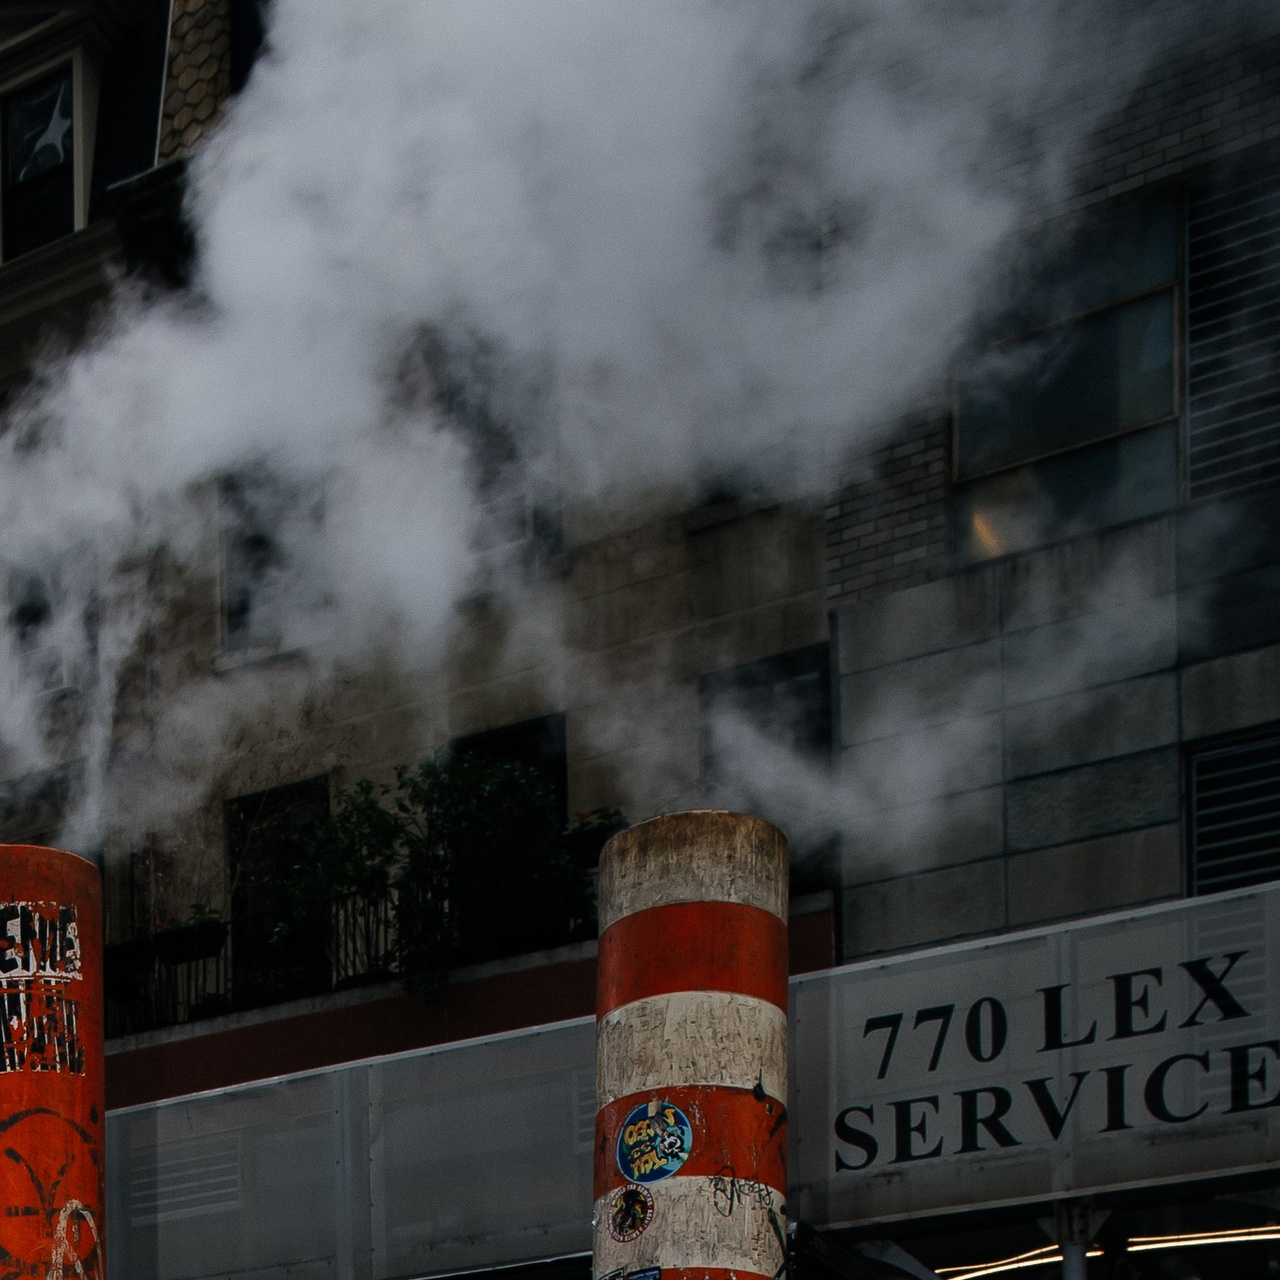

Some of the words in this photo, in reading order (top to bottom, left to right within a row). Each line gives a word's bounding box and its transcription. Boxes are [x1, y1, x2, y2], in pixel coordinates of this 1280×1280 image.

[863, 997, 1008, 1080] 770
[1035, 950, 1251, 1053] LEX
[834, 1040, 1280, 1173] SERVICE
